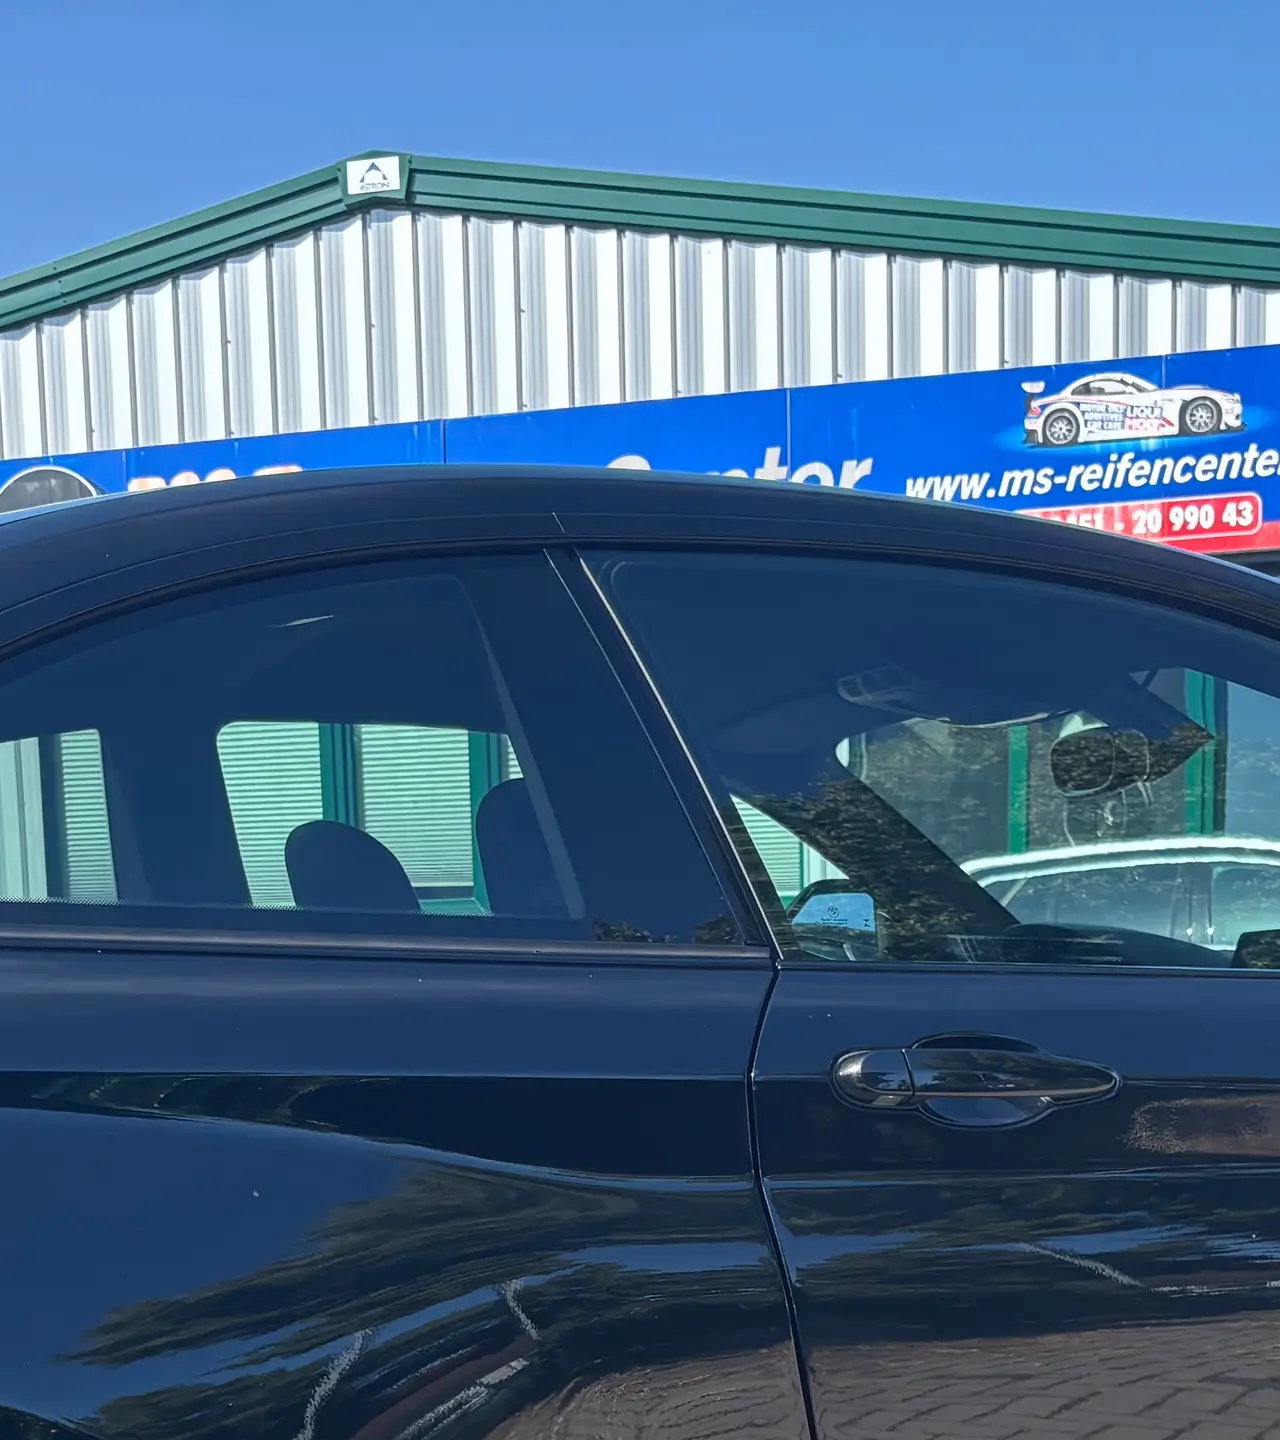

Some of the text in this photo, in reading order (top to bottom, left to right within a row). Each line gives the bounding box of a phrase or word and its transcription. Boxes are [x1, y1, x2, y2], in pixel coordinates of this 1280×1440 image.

[1131, 508, 1162, 535] 20
[1170, 504, 1215, 532] 990
[1222, 501, 1254, 526] 43
